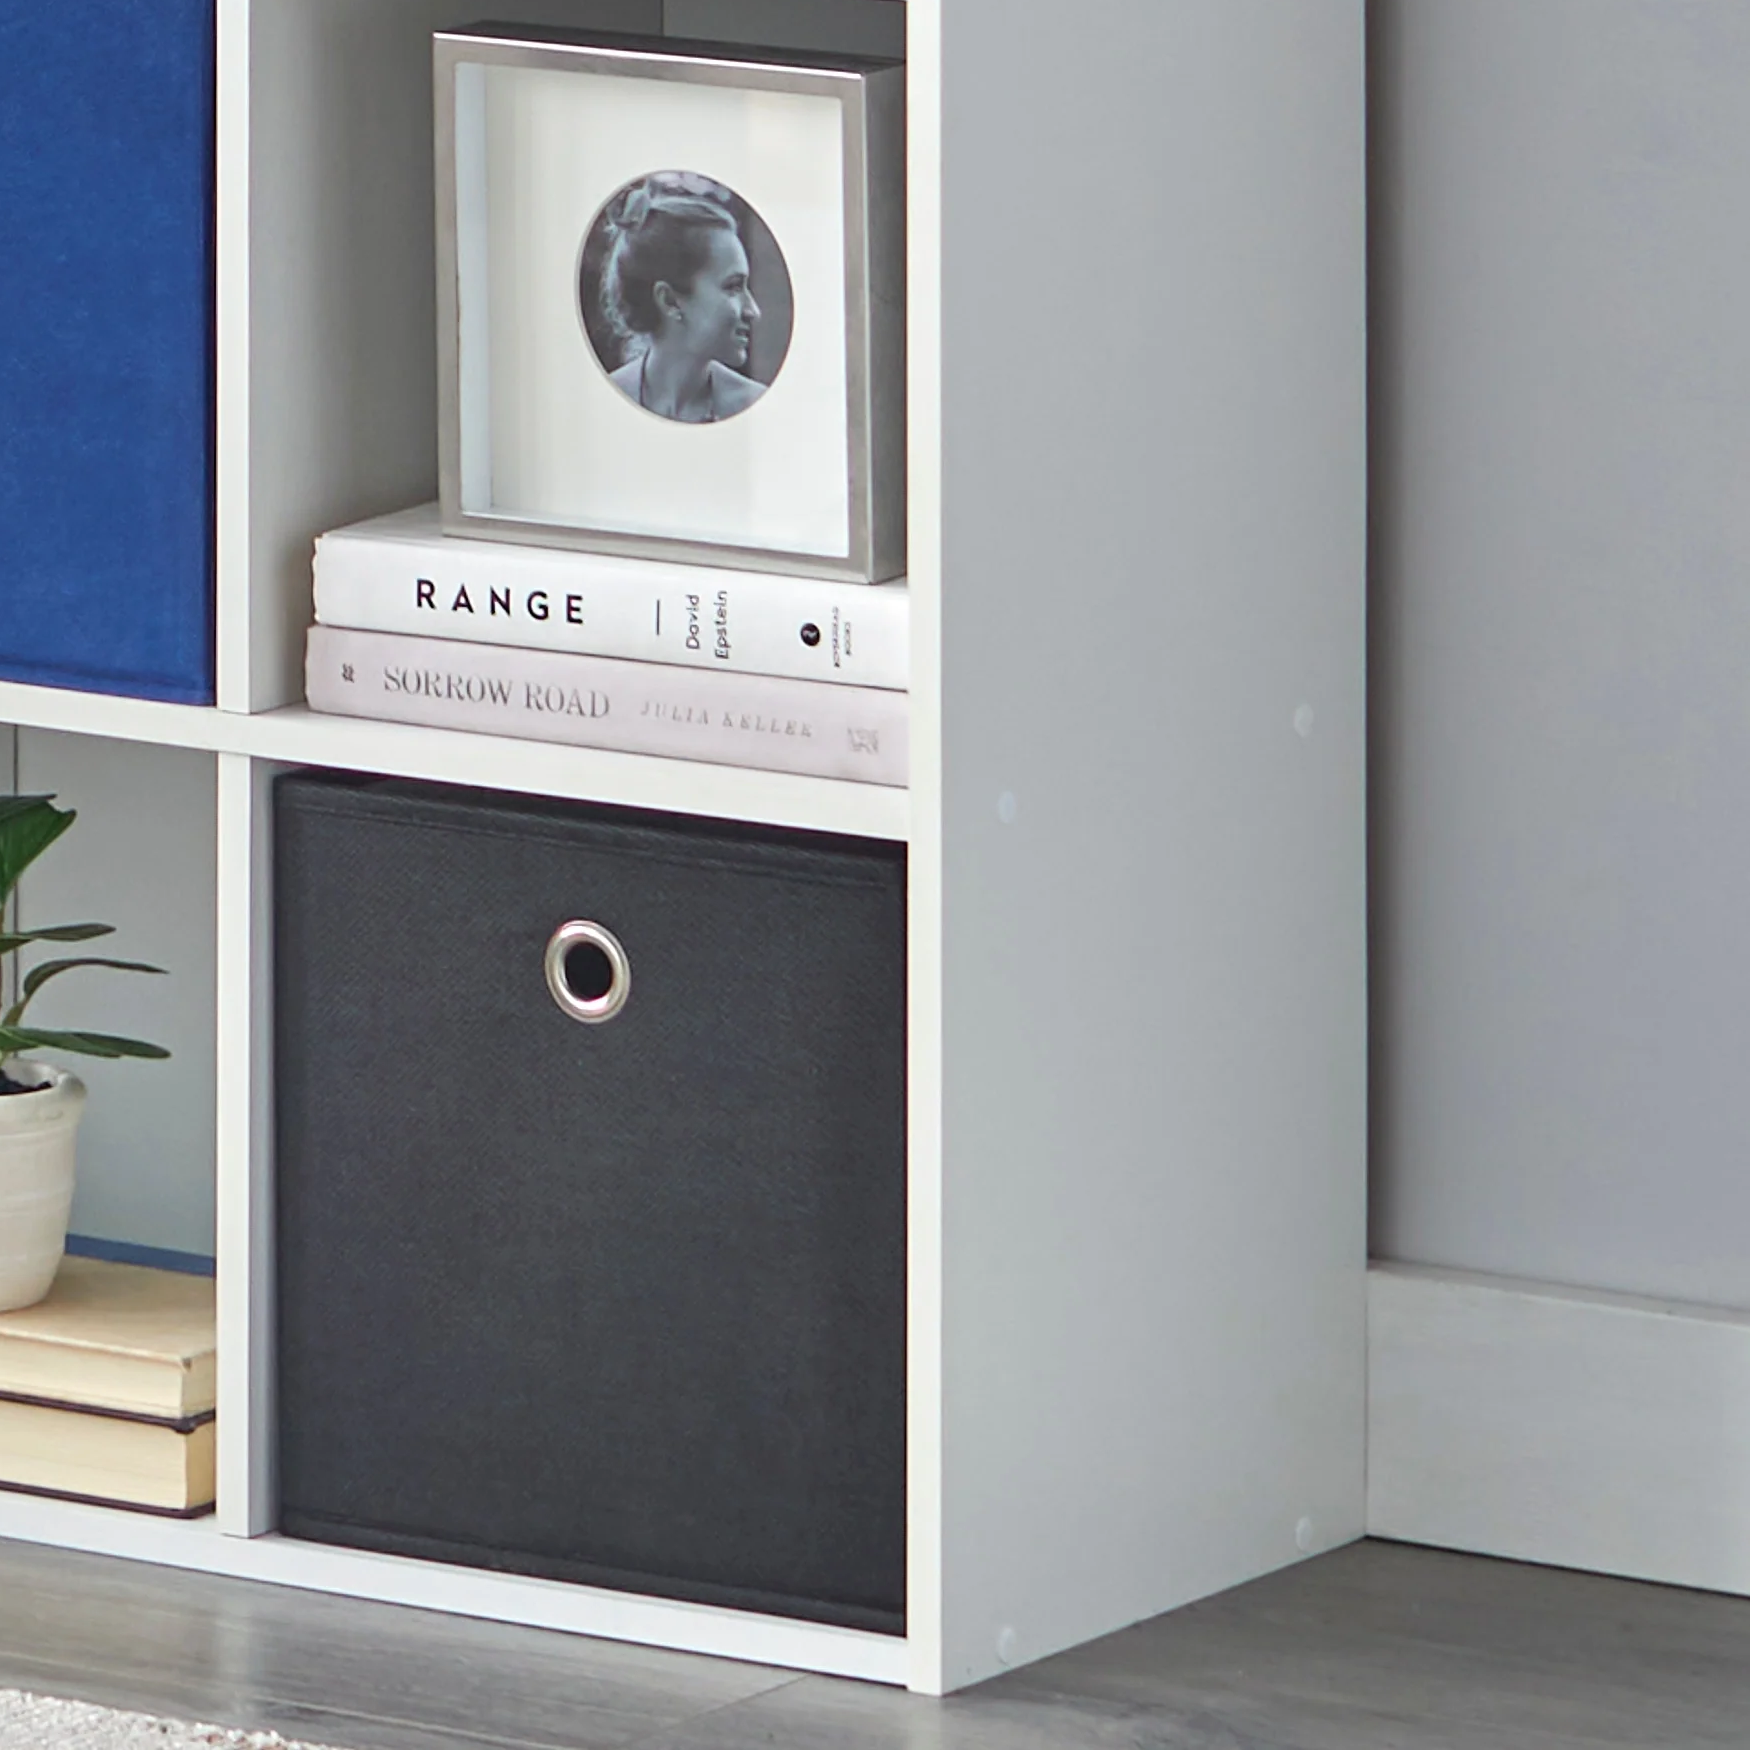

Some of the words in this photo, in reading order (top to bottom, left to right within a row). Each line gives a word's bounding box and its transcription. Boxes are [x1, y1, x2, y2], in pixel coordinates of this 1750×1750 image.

[416, 578, 584, 625] RANGE
[685, 594, 700, 650] David
[713, 590, 731, 659] Epstein
[383, 665, 514, 707] SORROW
[523, 681, 611, 719] ROAD
[639, 700, 709, 725] JULIA
